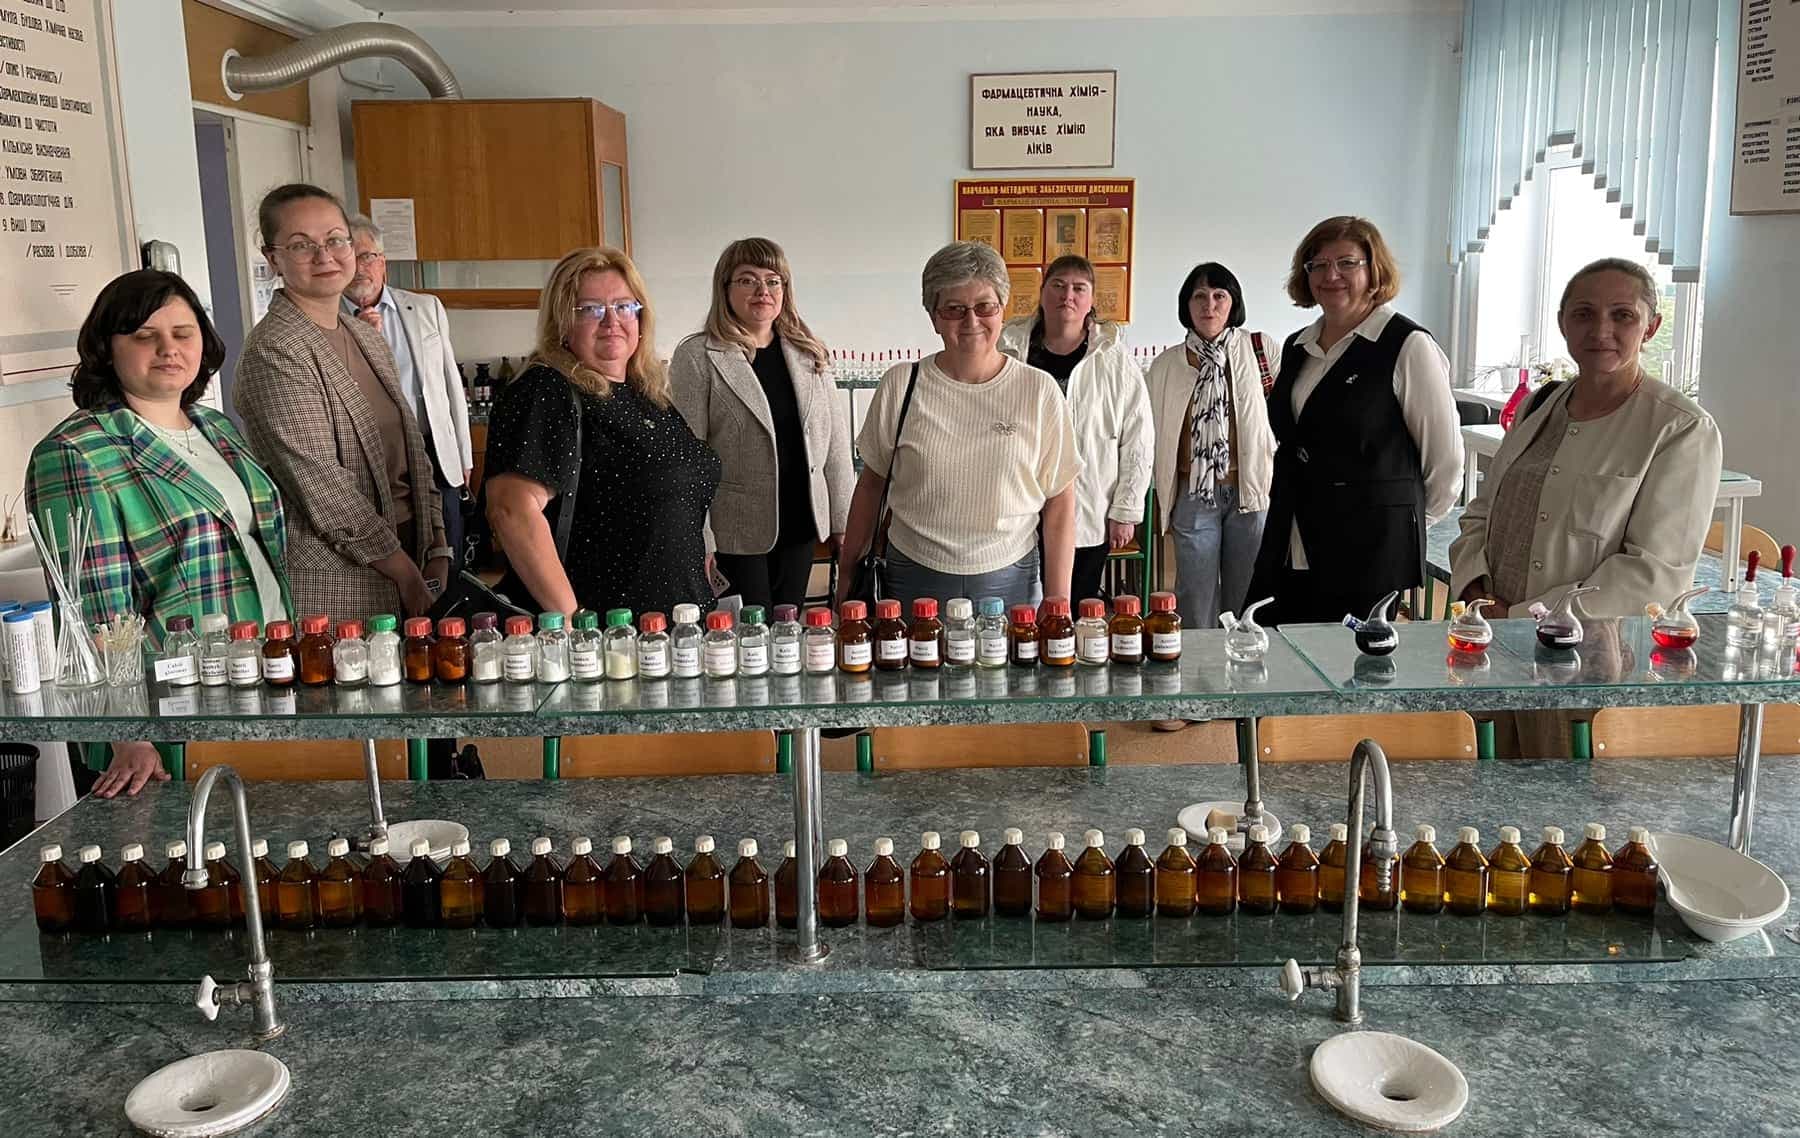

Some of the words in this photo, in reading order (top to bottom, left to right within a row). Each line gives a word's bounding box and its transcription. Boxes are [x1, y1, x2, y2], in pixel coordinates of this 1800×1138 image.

[981, 87, 1064, 100] ФАРМАЦЕВТИЧНА
[1026, 106, 1062, 118] НАУКА,
[985, 126, 1005, 138] ЯКА
[1011, 125, 1047, 137] ВИВЧАЄ
[1056, 122, 1086, 136] ХІМІЮ
[1026, 142, 1053, 155] ЛІКІВ
